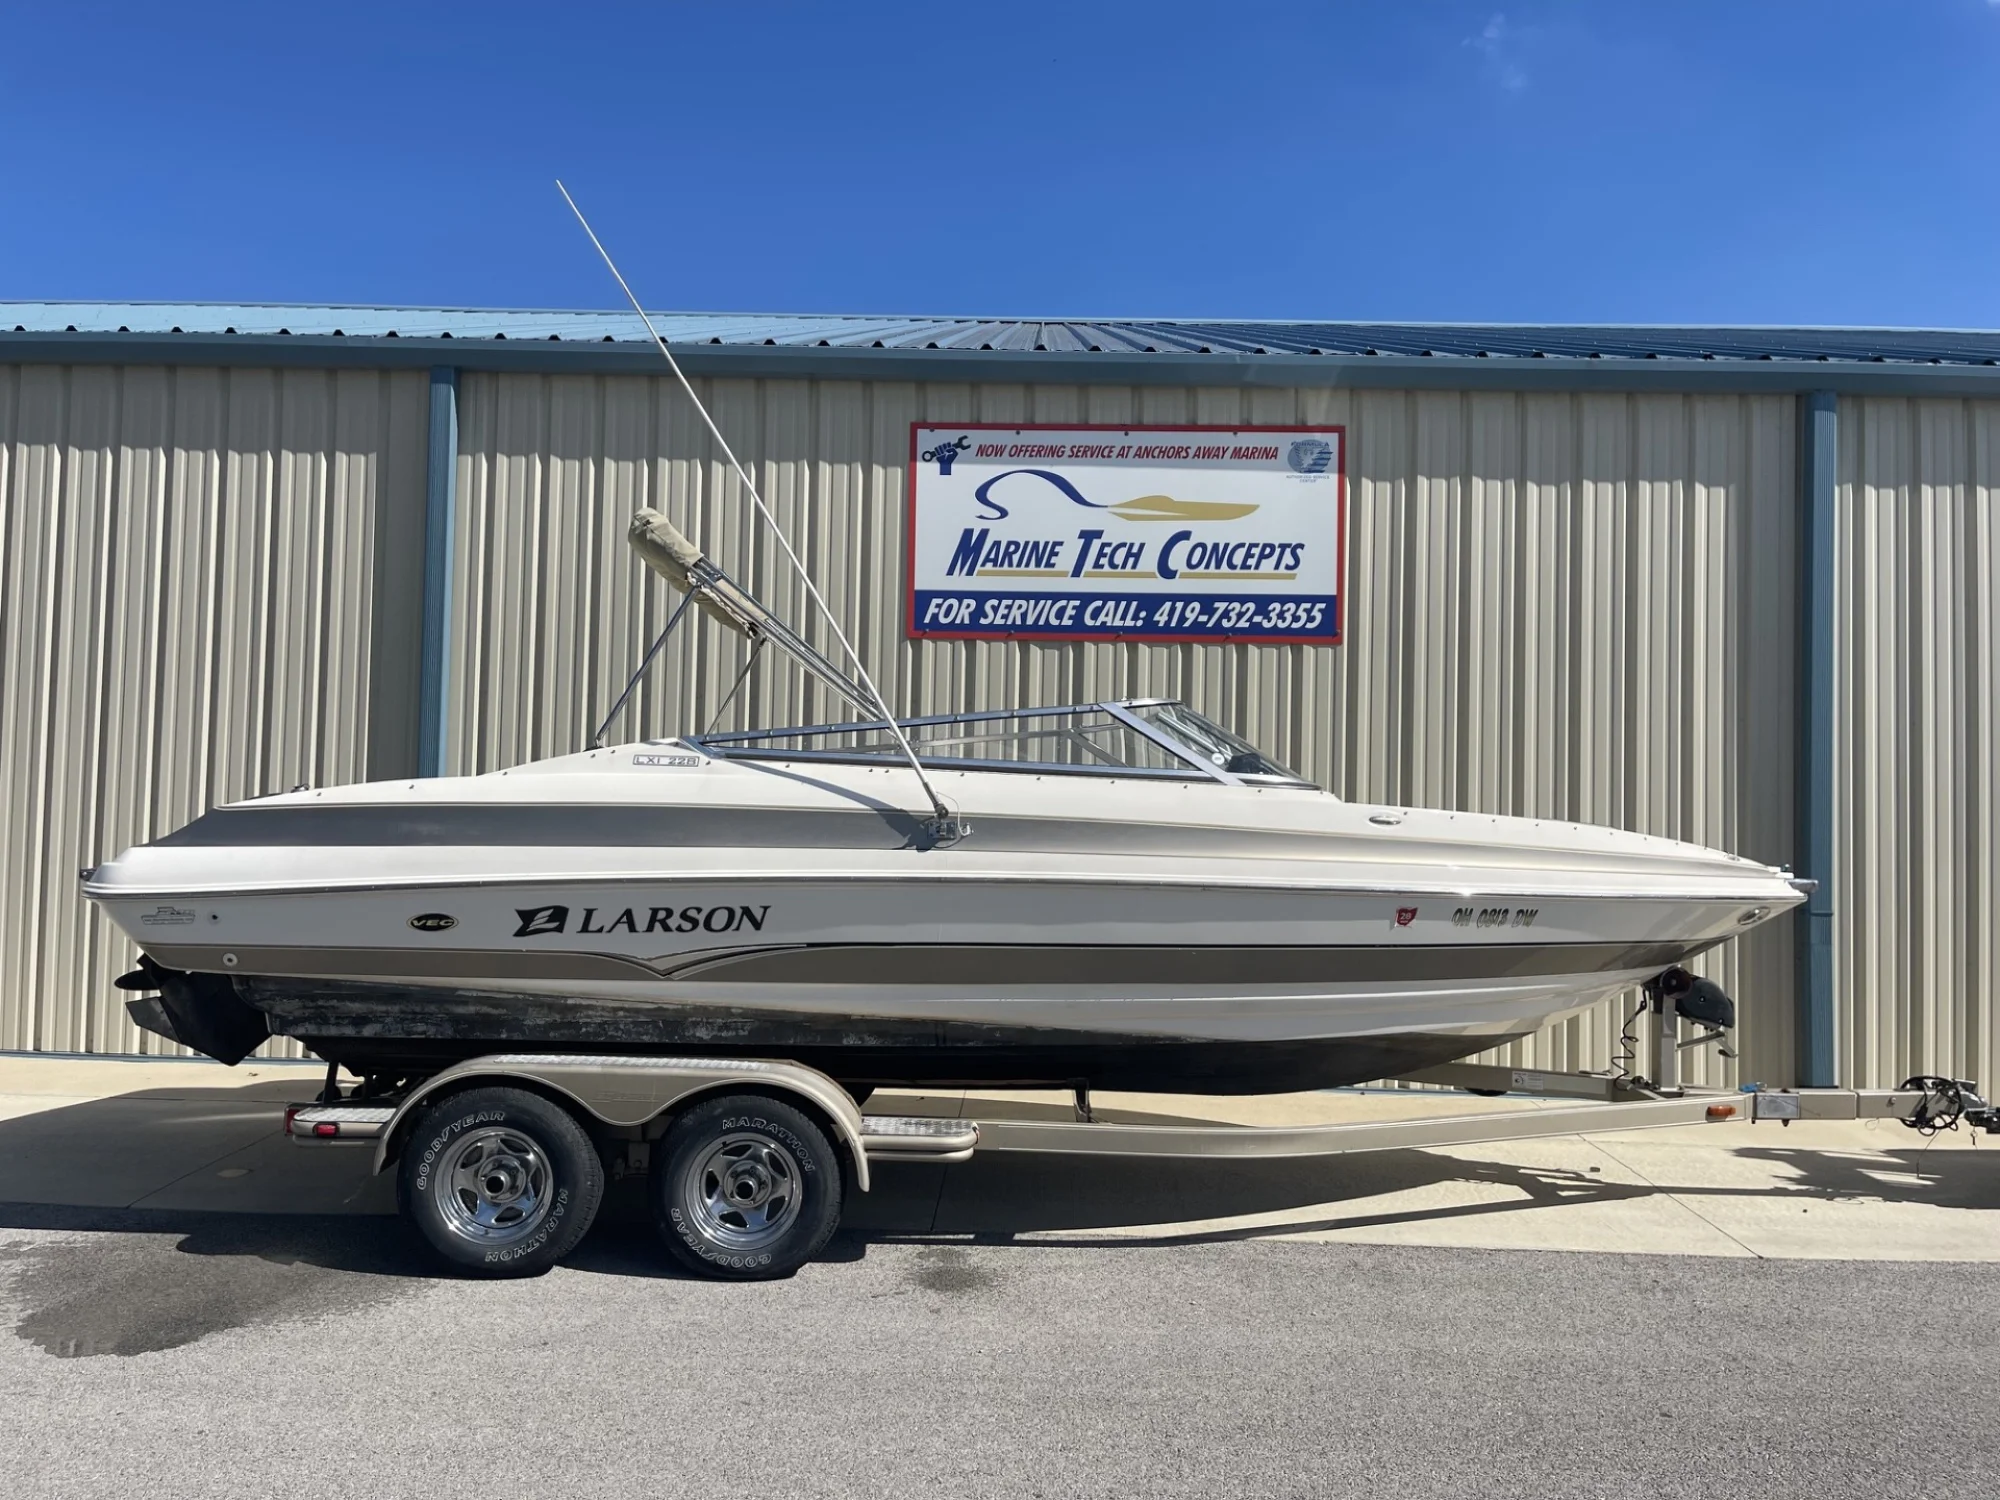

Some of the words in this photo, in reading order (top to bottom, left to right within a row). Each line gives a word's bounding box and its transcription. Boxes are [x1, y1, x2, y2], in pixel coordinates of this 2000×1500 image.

[975, 443, 1007, 457] NOW
[1008, 444, 1066, 458] OFFERING
[1068, 445, 1116, 459] SERVICE
[1116, 445, 1133, 459] AT
[1133, 445, 1191, 460] ANCHORS
[1192, 446, 1230, 460] AWAY
[1230, 446, 1279, 461] MARINA
[923, 597, 978, 625] FOR
[979, 598, 1081, 627] SERVICE
[1083, 600, 1147, 628] CALL:
[1153, 602, 1326, 629] 419-732-3355
[576, 905, 771, 933] LARSON
[1451, 907, 1474, 927] OH
[1511, 908, 1539, 928] DW
[416, 1111, 505, 1190] GOODYEAR
[723, 1116, 815, 1172] MARATHON
[485, 1187, 568, 1262] MARATHON
[671, 1207, 772, 1268] GOODYEAR
